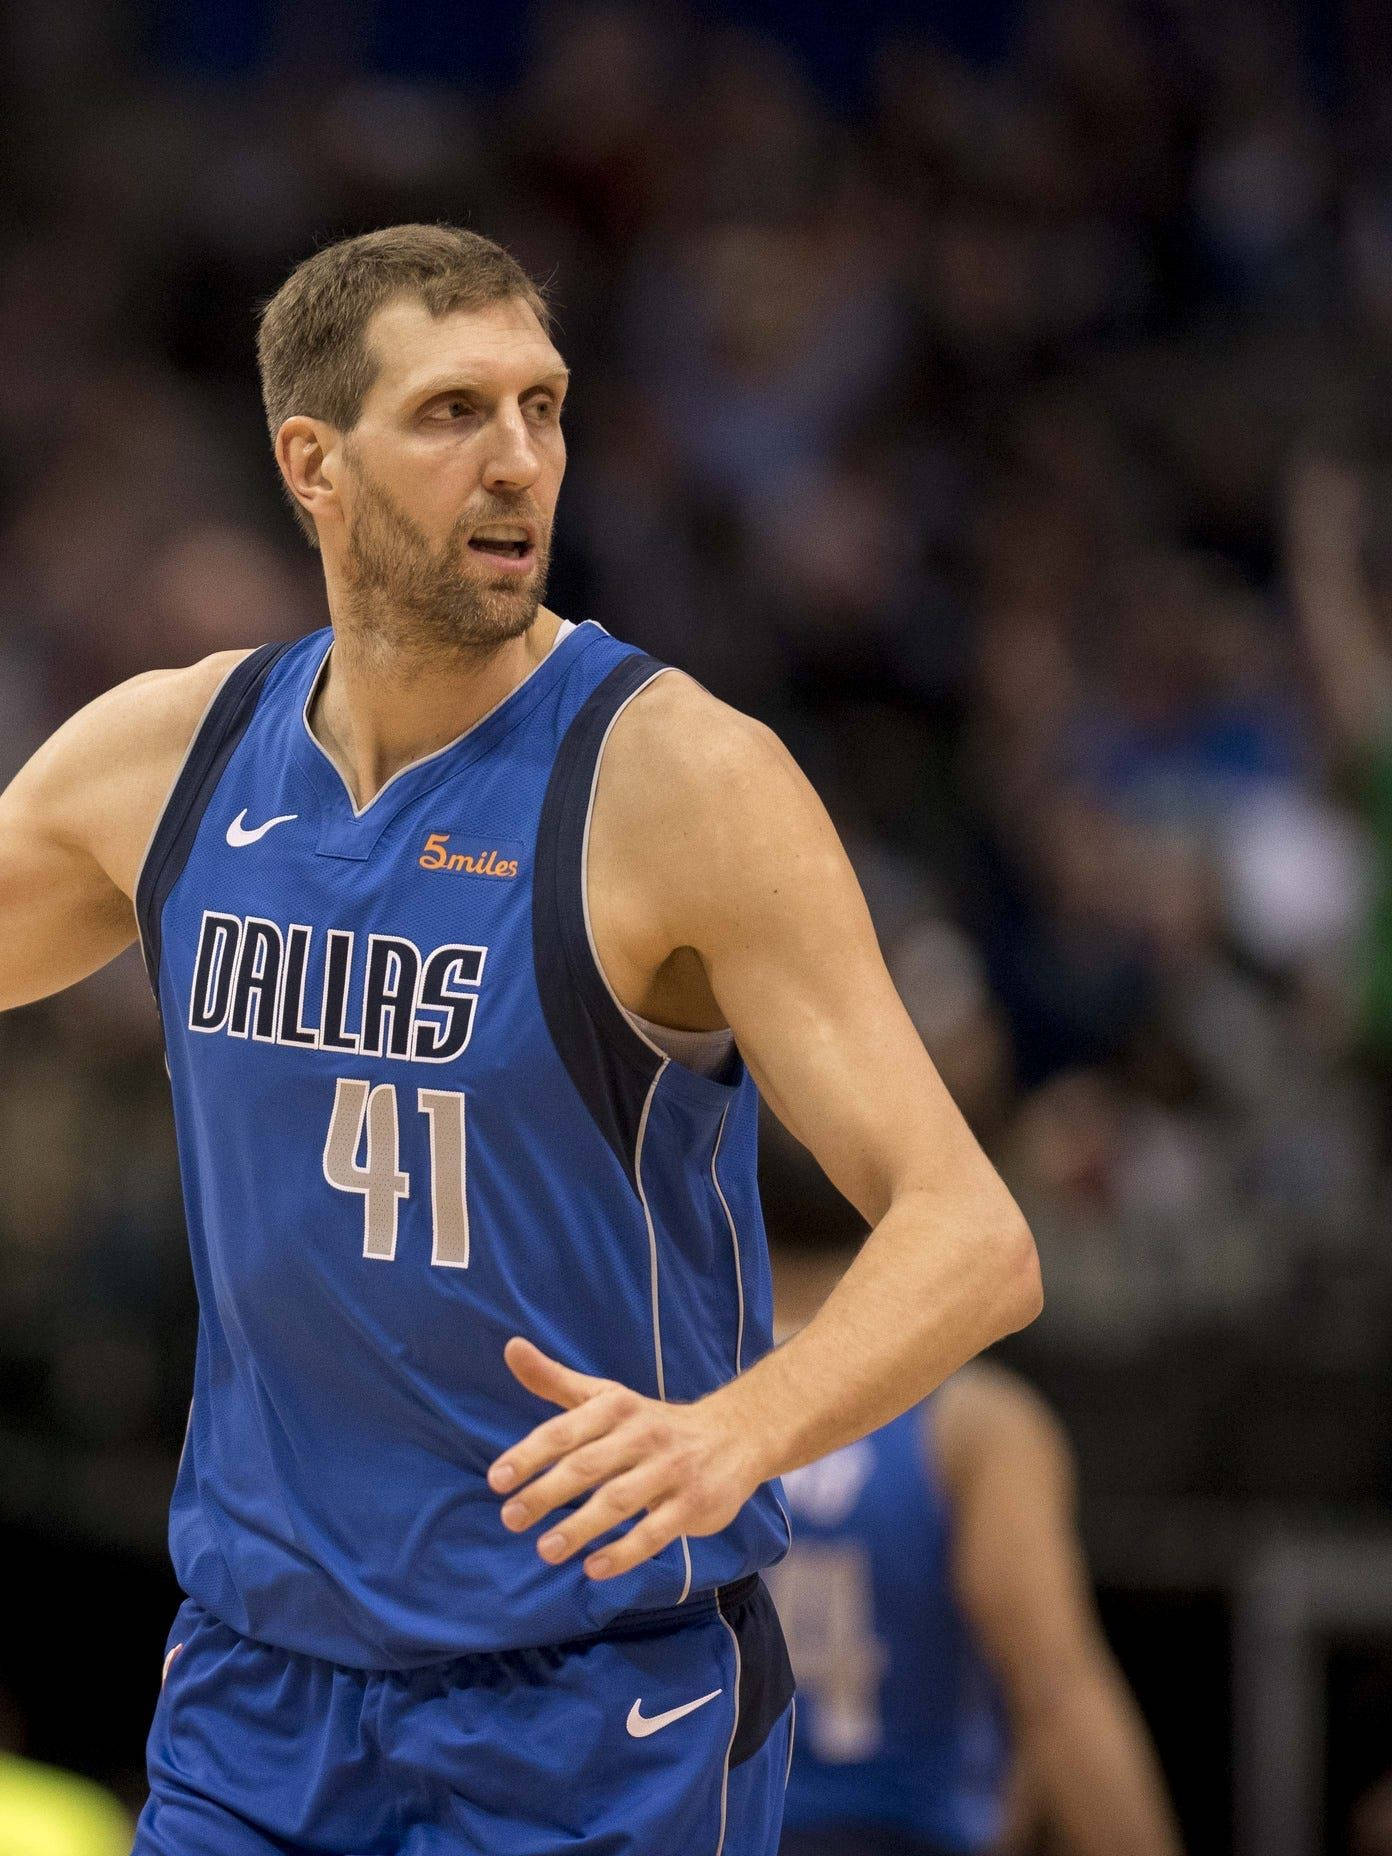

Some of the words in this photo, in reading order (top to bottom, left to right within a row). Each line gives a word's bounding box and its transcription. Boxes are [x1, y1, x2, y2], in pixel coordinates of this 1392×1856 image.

[419, 834, 518, 877] 5miles
[189, 911, 488, 1063] DALLAS
[323, 1078, 470, 1268] 41
